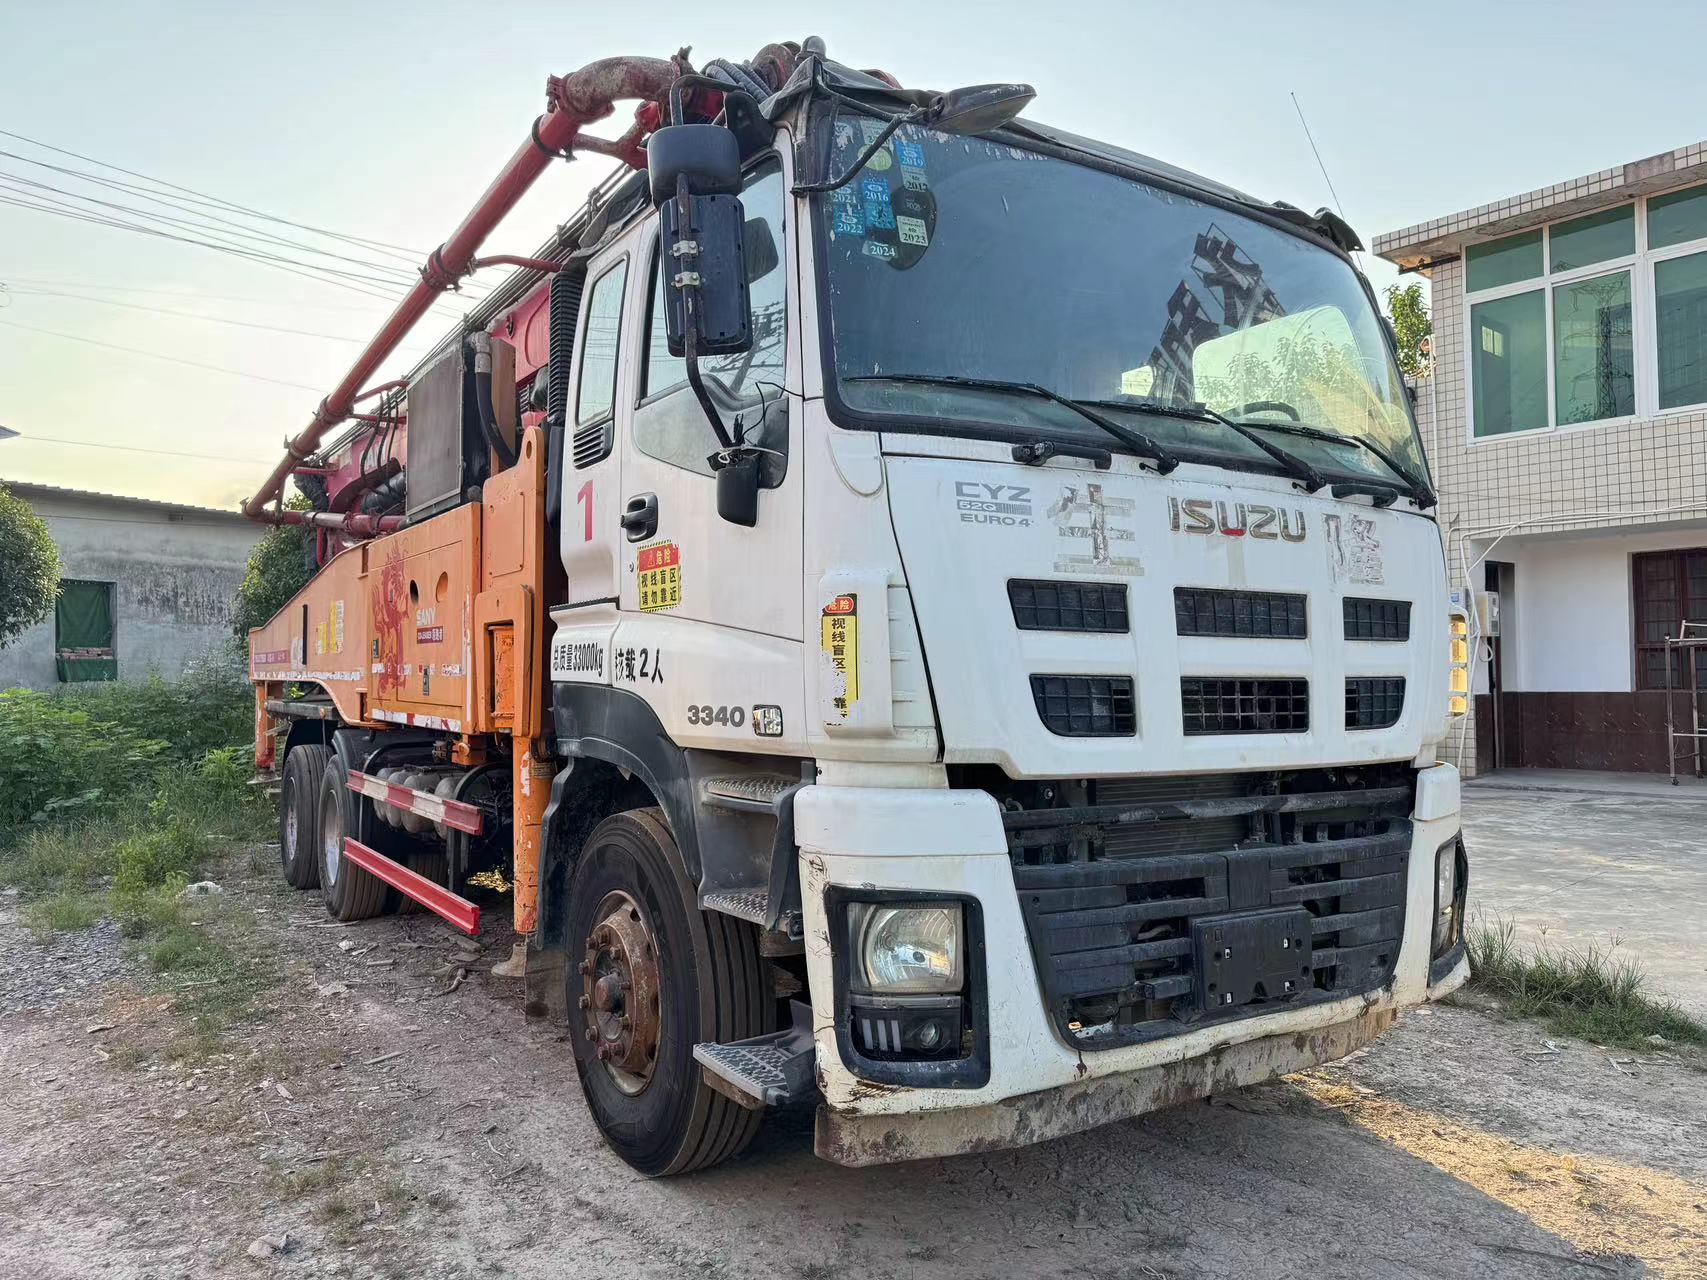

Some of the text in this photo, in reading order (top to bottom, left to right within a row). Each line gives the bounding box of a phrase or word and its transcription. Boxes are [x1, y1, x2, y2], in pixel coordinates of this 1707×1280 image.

[864, 190, 889, 201] 2016
[837, 222, 863, 234] 2022
[902, 233, 926, 244] 2023
[870, 245, 896, 257] 2024
[955, 481, 1032, 503] CYZ
[577, 479, 593, 542] 1
[1167, 495, 1306, 543] ISUZU
[641, 567, 677, 588] 视线盲区
[687, 704, 746, 728] 3340
